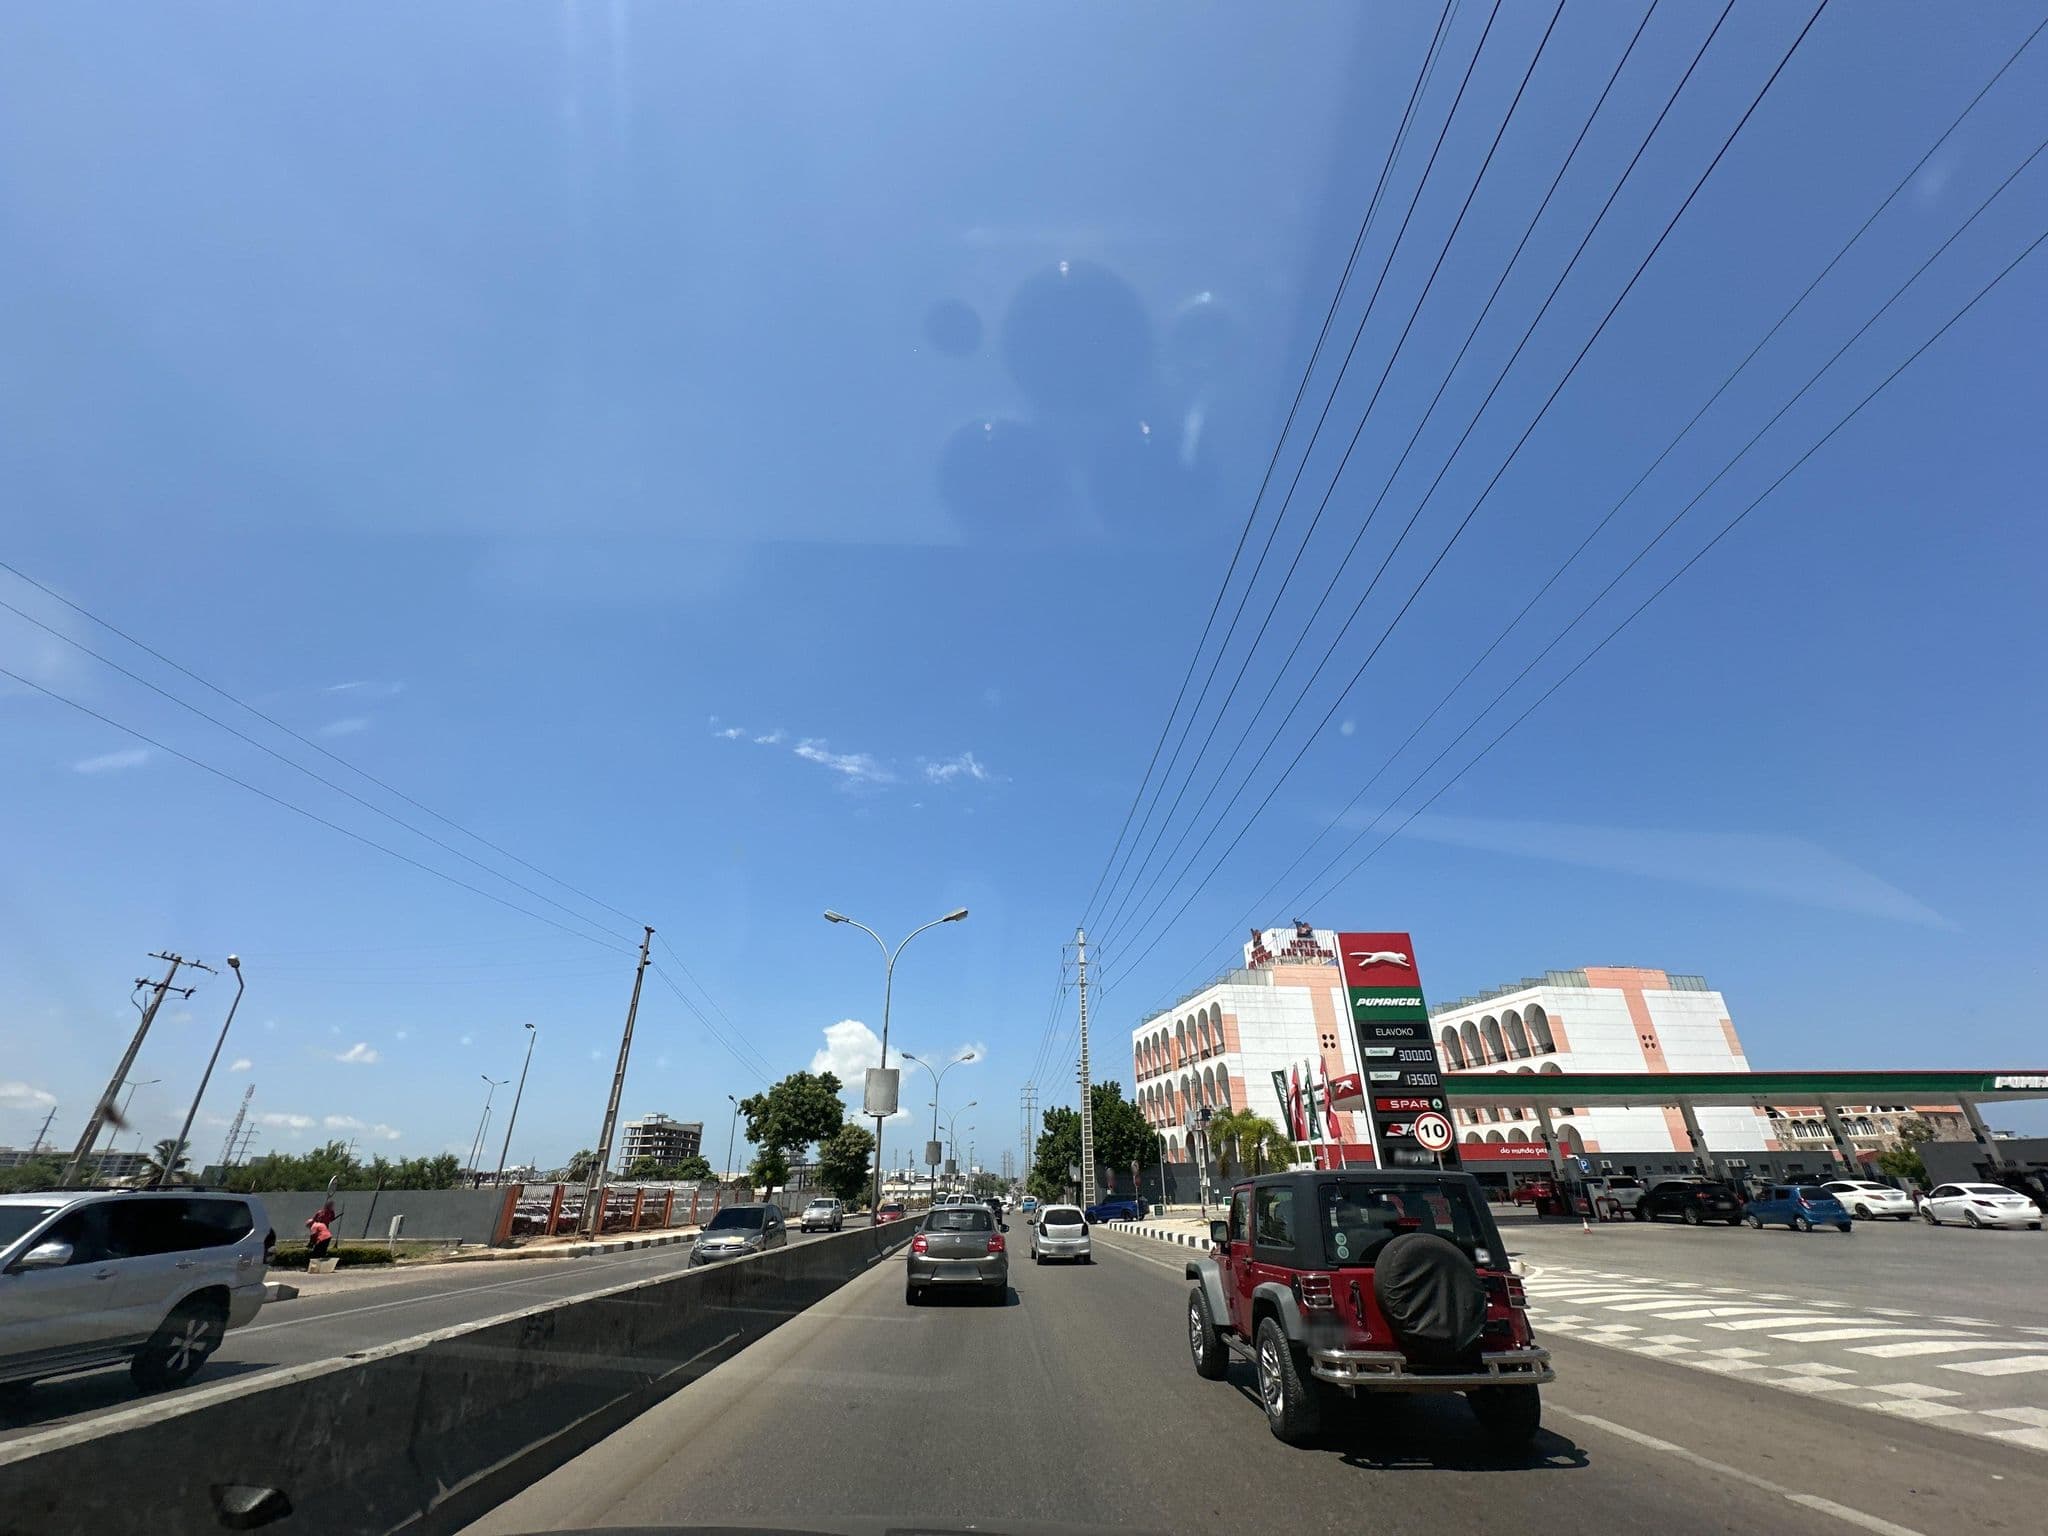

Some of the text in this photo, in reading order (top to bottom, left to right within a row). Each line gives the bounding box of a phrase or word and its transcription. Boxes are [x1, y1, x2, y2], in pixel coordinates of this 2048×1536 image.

[1289, 939, 1321, 949] HOTEL
[1375, 1027, 1414, 1037] ELAVOKO
[1994, 1075, 2048, 1089] PUMA
[1390, 1099, 1430, 1109] SPAR
[1421, 1123, 1445, 1138] 10
[1500, 1146, 1510, 1154] do
[1511, 1146, 1535, 1154] mundo
